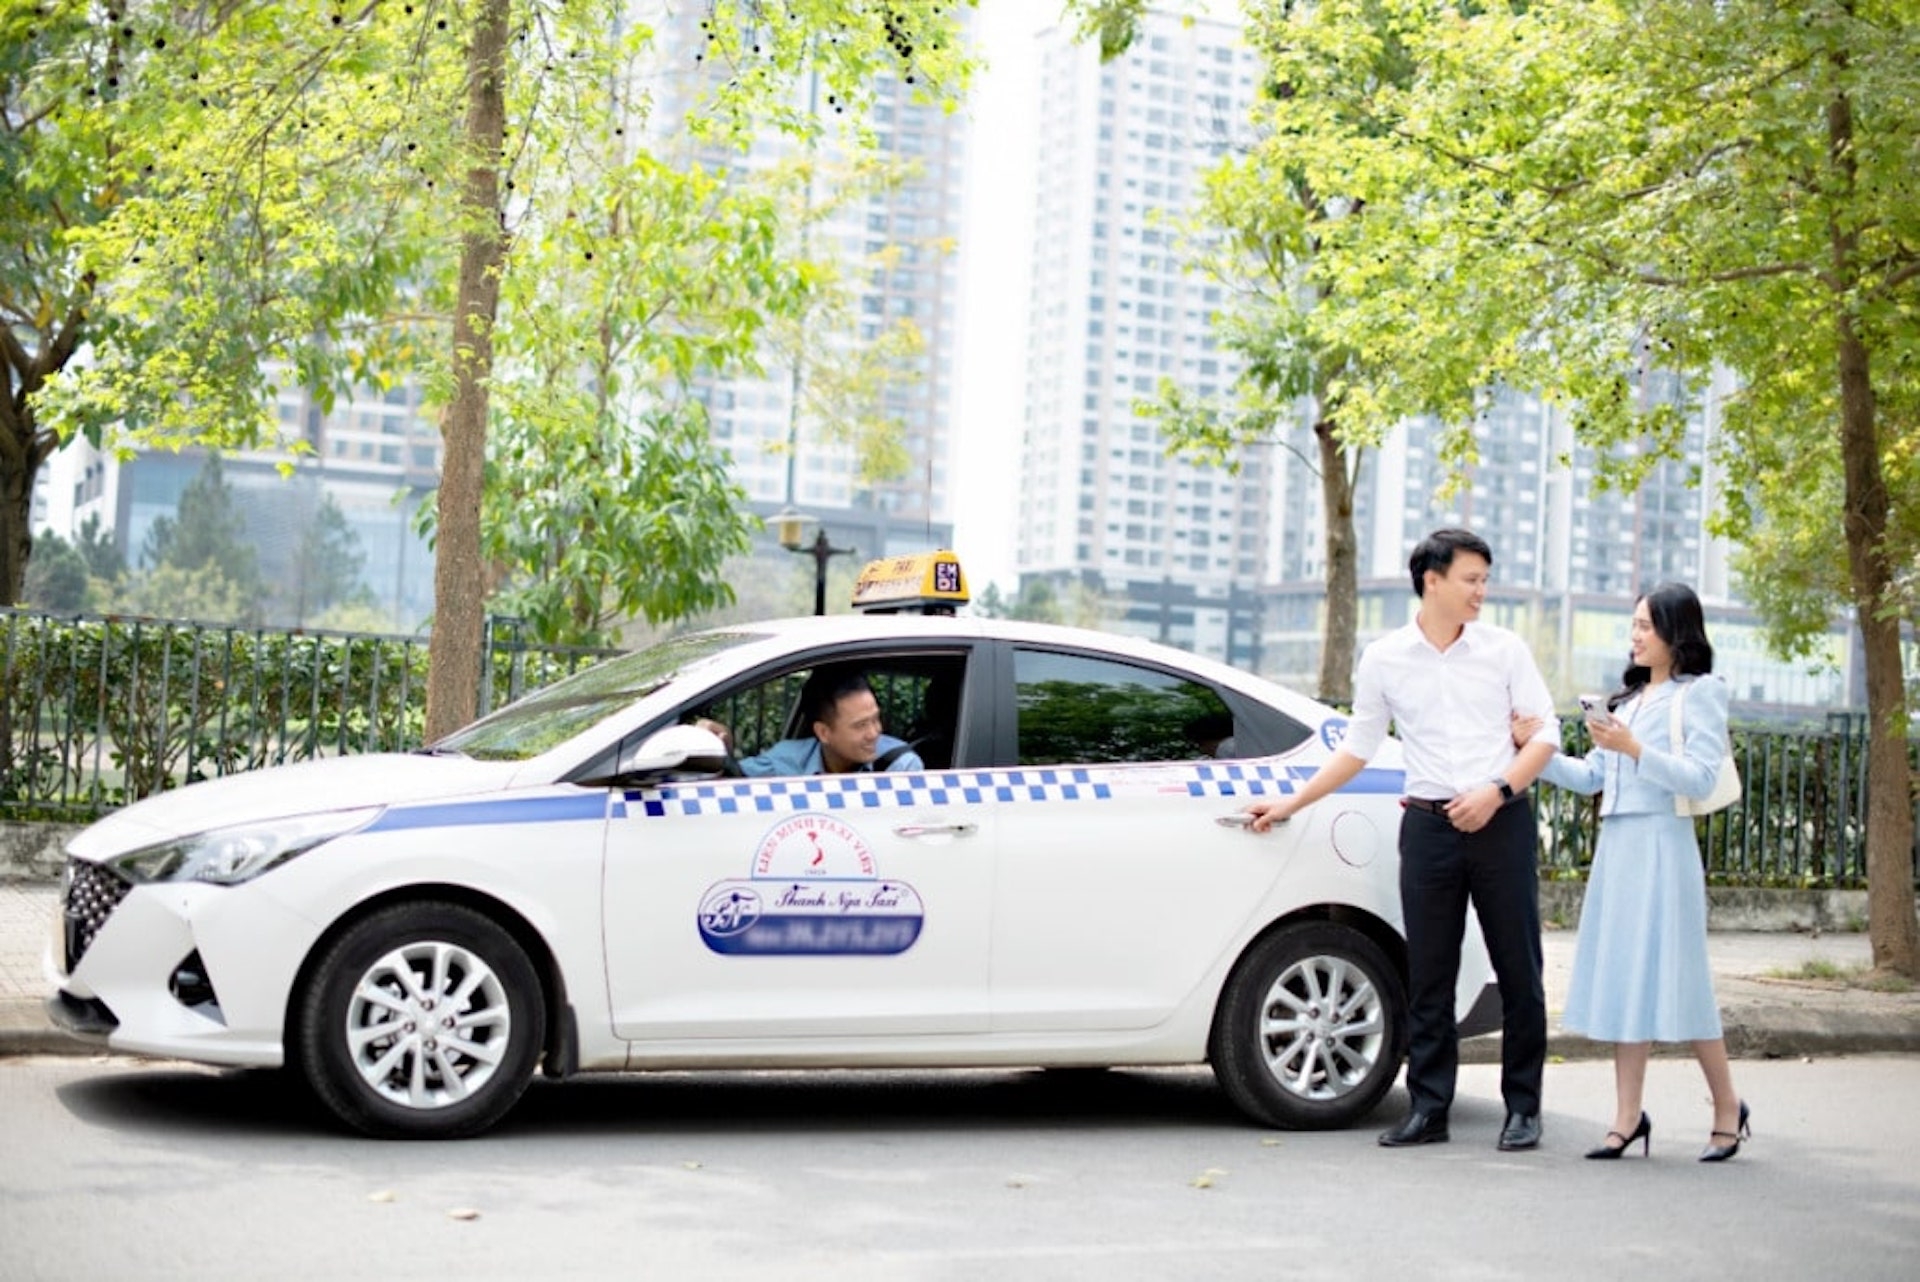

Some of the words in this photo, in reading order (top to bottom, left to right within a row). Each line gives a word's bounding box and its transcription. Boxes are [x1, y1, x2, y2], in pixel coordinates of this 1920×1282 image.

[775, 817, 814, 841] MINH
[818, 818, 853, 841] TAXI
[774, 885, 825, 908] Thanh
[829, 892, 861, 912] Nga
[865, 885, 899, 907] Taxi
